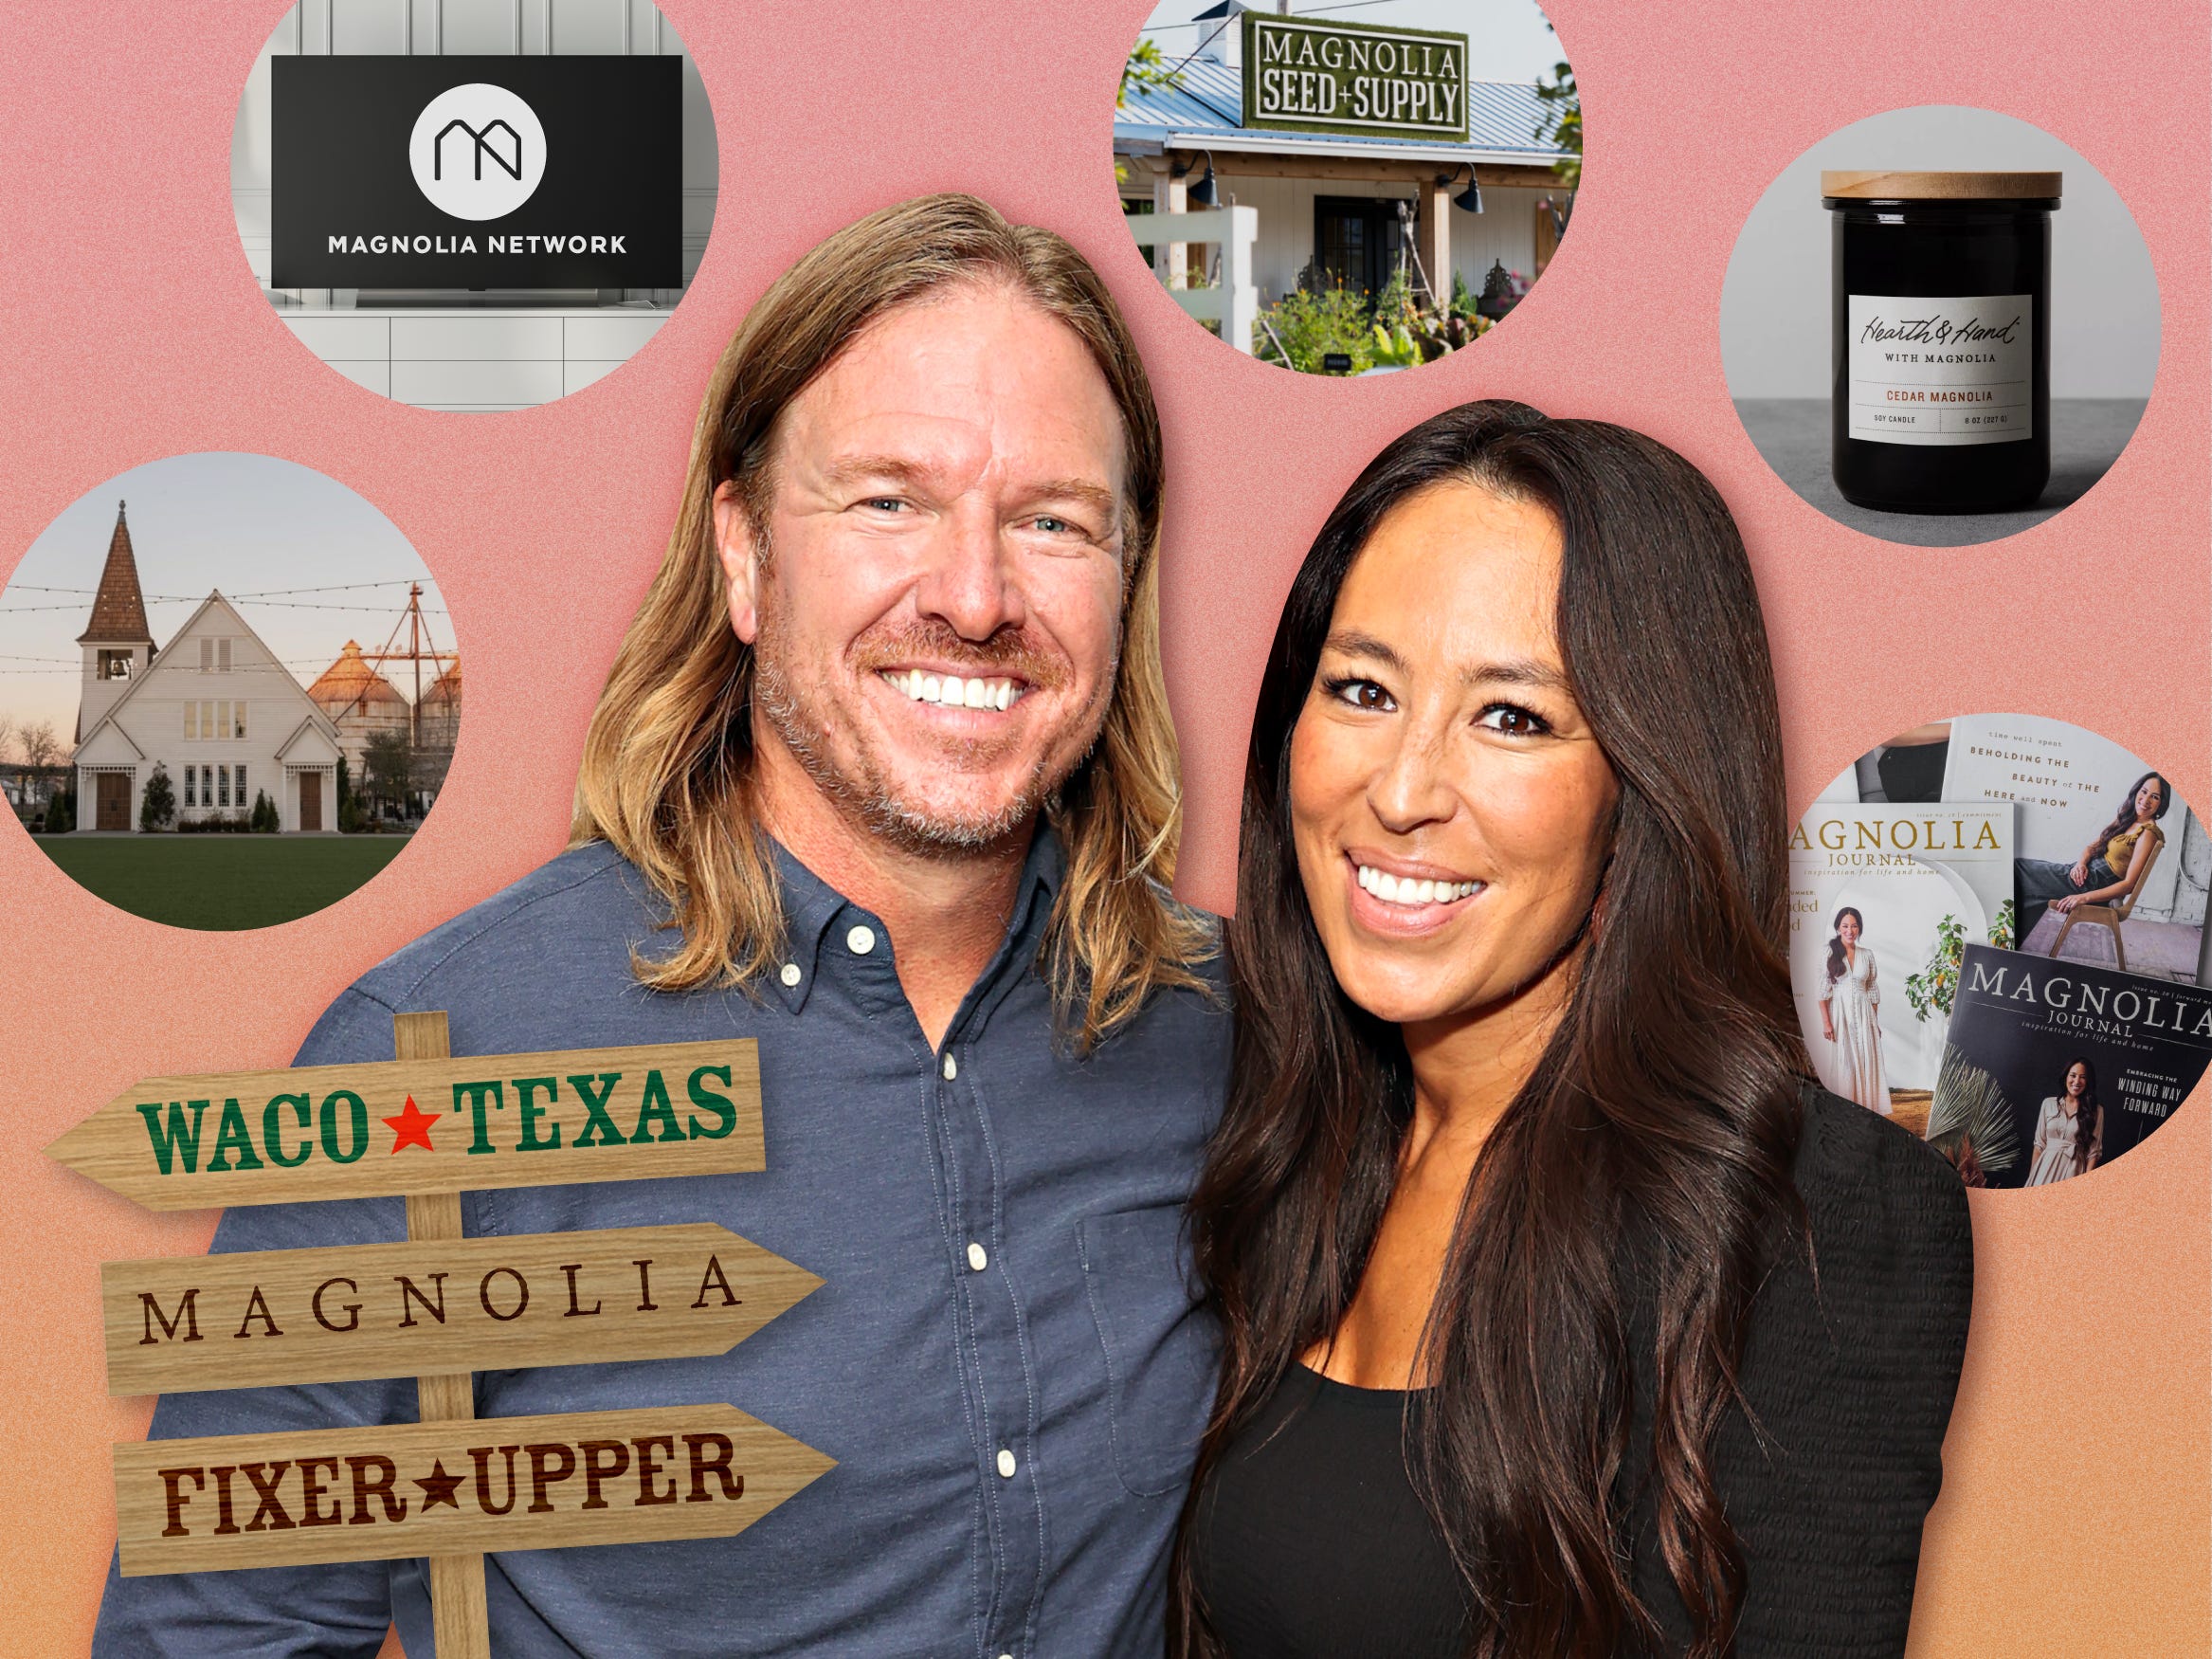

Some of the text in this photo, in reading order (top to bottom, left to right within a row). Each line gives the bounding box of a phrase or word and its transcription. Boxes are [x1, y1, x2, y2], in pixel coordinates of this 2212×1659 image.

[1263, 30, 1459, 79] MAGNOLIA
[328, 235, 627, 254] MAGNOLIA NETWORK
[1860, 315, 2021, 345] Hearth & Hand
[1885, 353, 1996, 363] WITH MAGNOLIA
[1887, 391, 1993, 403] CEDAR MAGNOLIA
[1874, 414, 1915, 424] SOY CANDLE
[1989, 731, 2063, 748] time well spent
[1970, 746, 2070, 768] BEHOLDING THE
[2012, 773, 2058, 787] BEAUTY
[2077, 783, 2100, 793] THE
[1985, 789, 2015, 800] HERE
[2040, 797, 2068, 808] NOW
[1828, 853, 1916, 867] JOURNAL
[1804, 868, 1855, 877] inspiration
[1858, 867, 1873, 877] for
[1877, 867, 1893, 877] life
[1967, 962, 2212, 1038] MAGNOLIA
[2047, 1010, 2133, 1038] JOURNAL
[2022, 1021, 2154, 1051] inspiration for life and home
[2126, 1068, 2164, 1081] EMBRACING
[2117, 1077, 2182, 1102] WINDING WAY
[2123, 1097, 2167, 1118] FORWARD
[136, 1065, 737, 1176] WACO TEXAS
[137, 1254, 742, 1345] MAGNOLIA
[157, 1432, 745, 1537] FIXER UPPER
